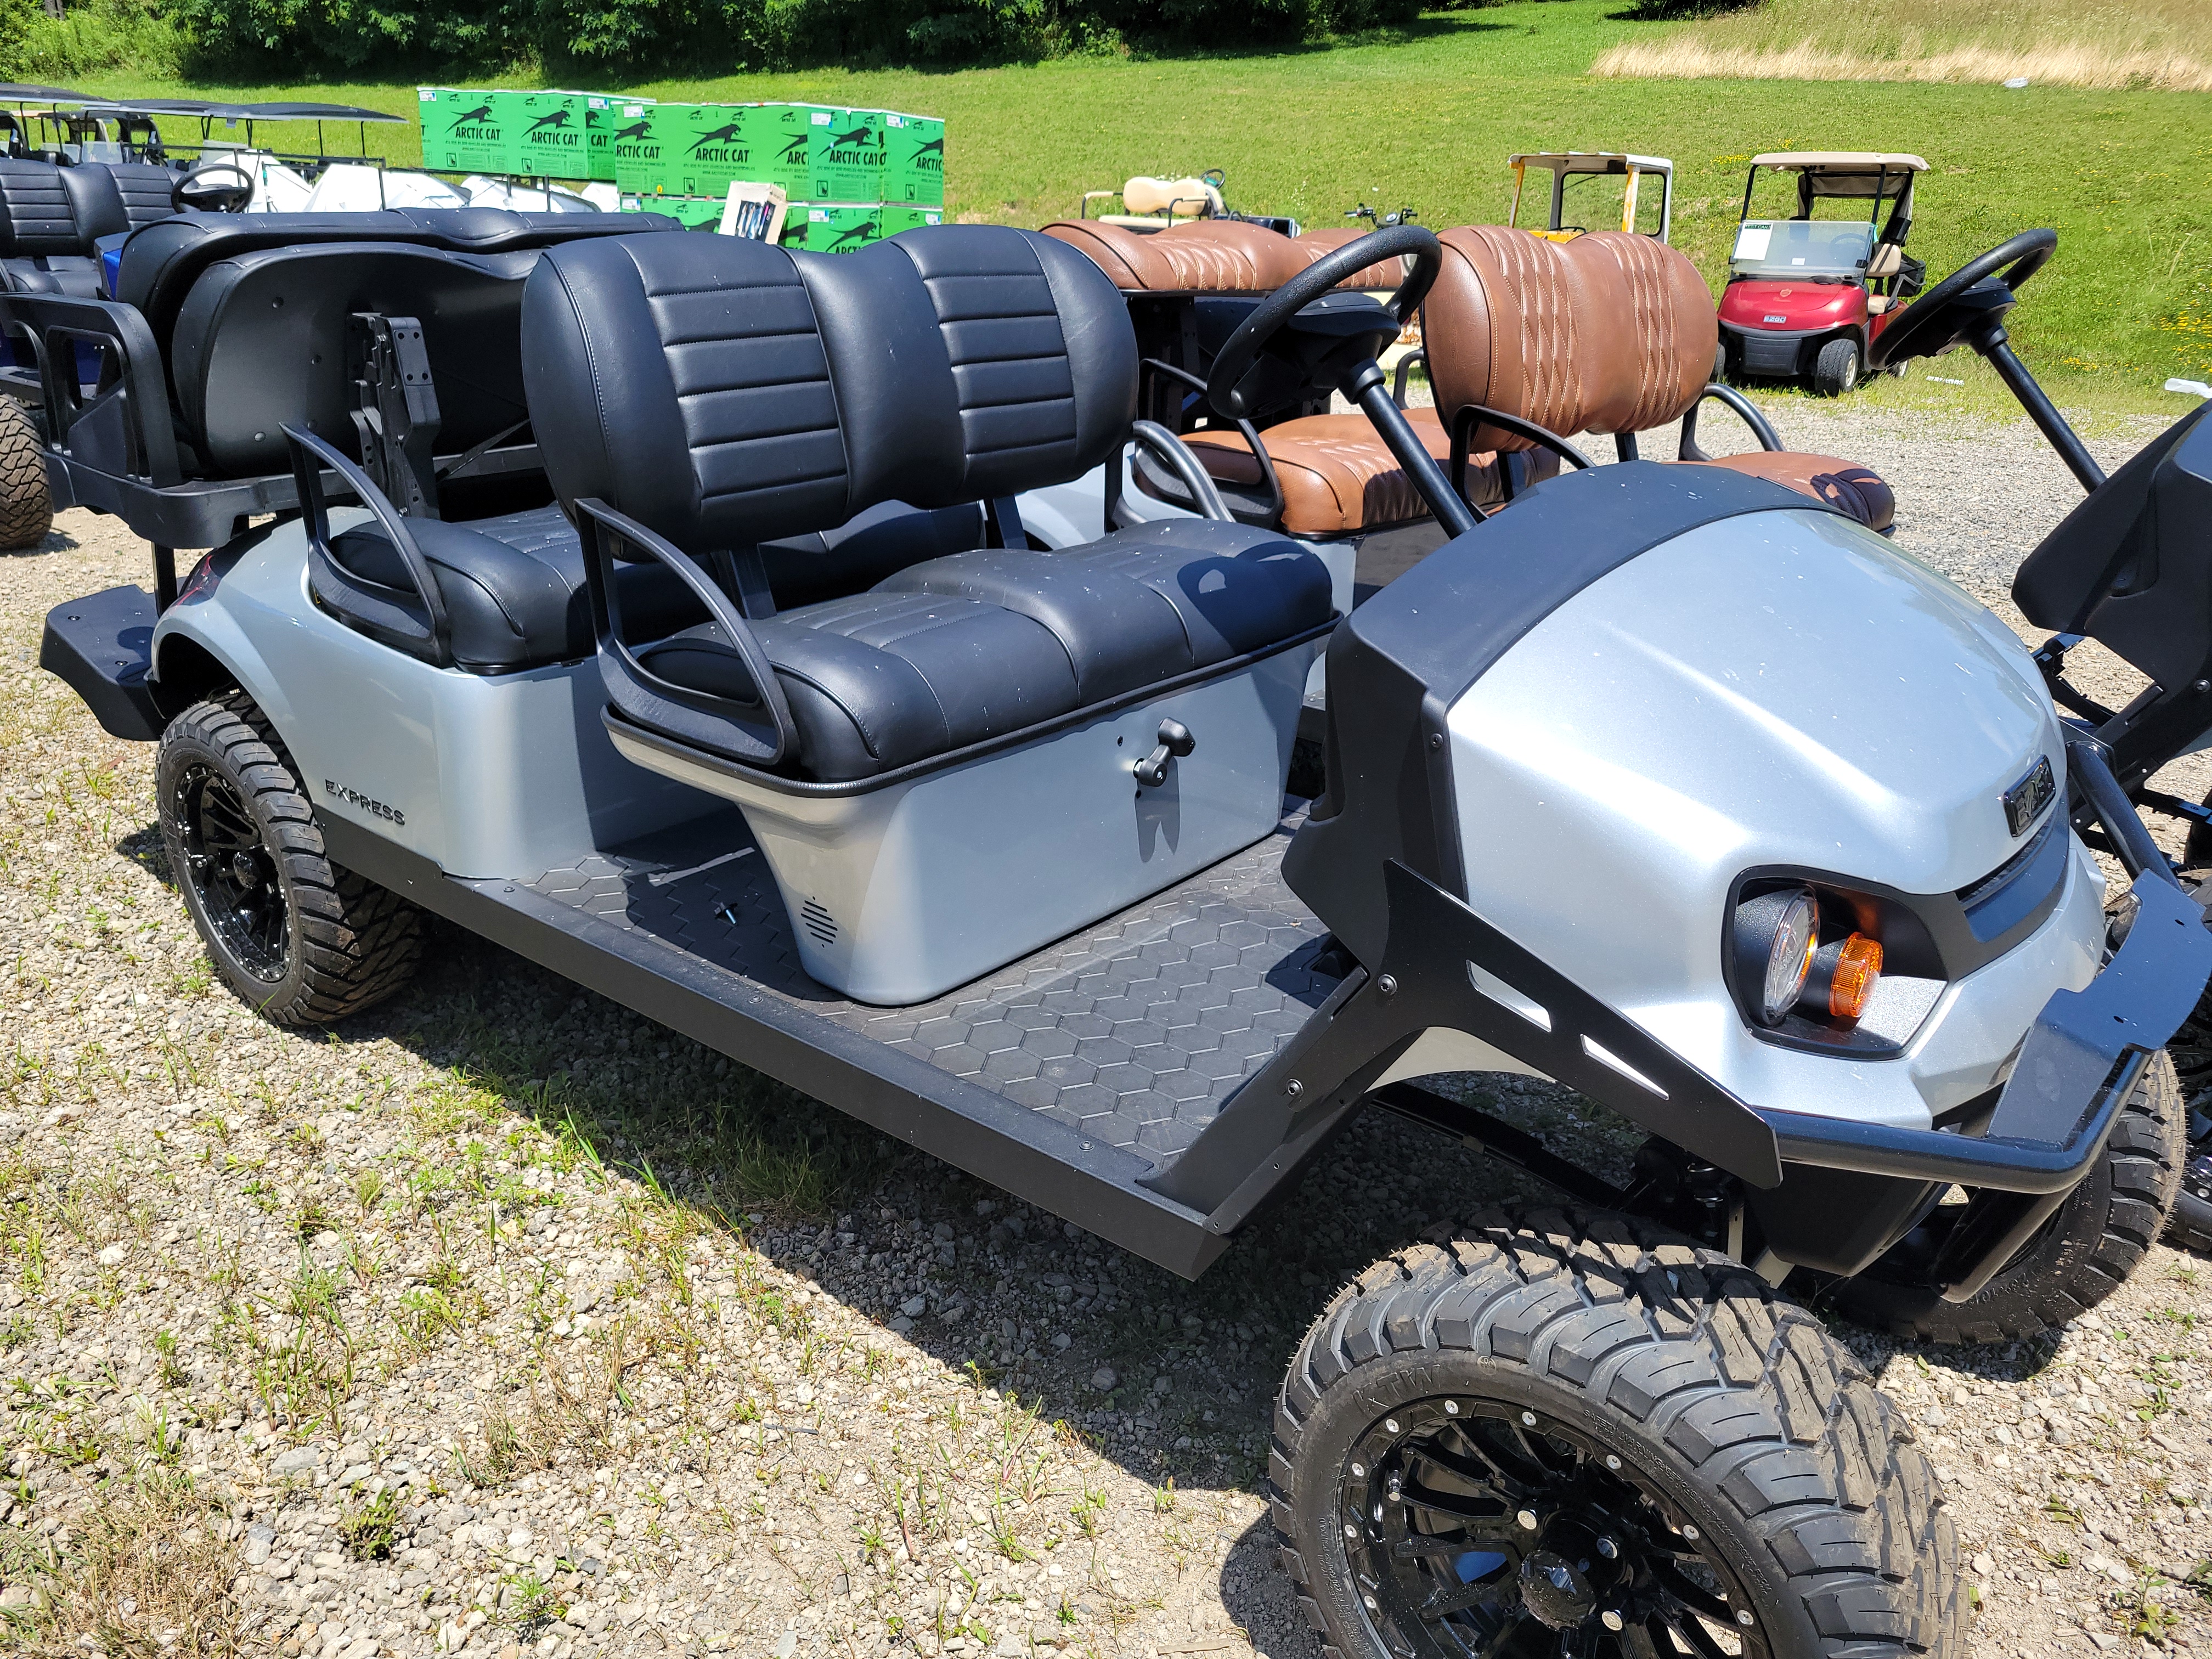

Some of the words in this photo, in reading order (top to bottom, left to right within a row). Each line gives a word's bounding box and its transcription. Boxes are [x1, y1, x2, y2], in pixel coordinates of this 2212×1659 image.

[456, 127, 483, 139] ARCTIC
[486, 128, 500, 141] CAT
[531, 132, 561, 145] ARCTIC
[563, 134, 578, 146] CAT
[591, 134, 608, 147] CAT
[617, 145, 641, 159] RCTIC
[644, 146, 660, 159] CAT
[696, 148, 729, 162] ARCTIC
[732, 149, 749, 163] CAT
[787, 151, 809, 165] ARC
[829, 150, 860, 165] ARCTIC
[916, 156, 942, 171] ARCTIC
[325, 779, 405, 826] EXPRESS
